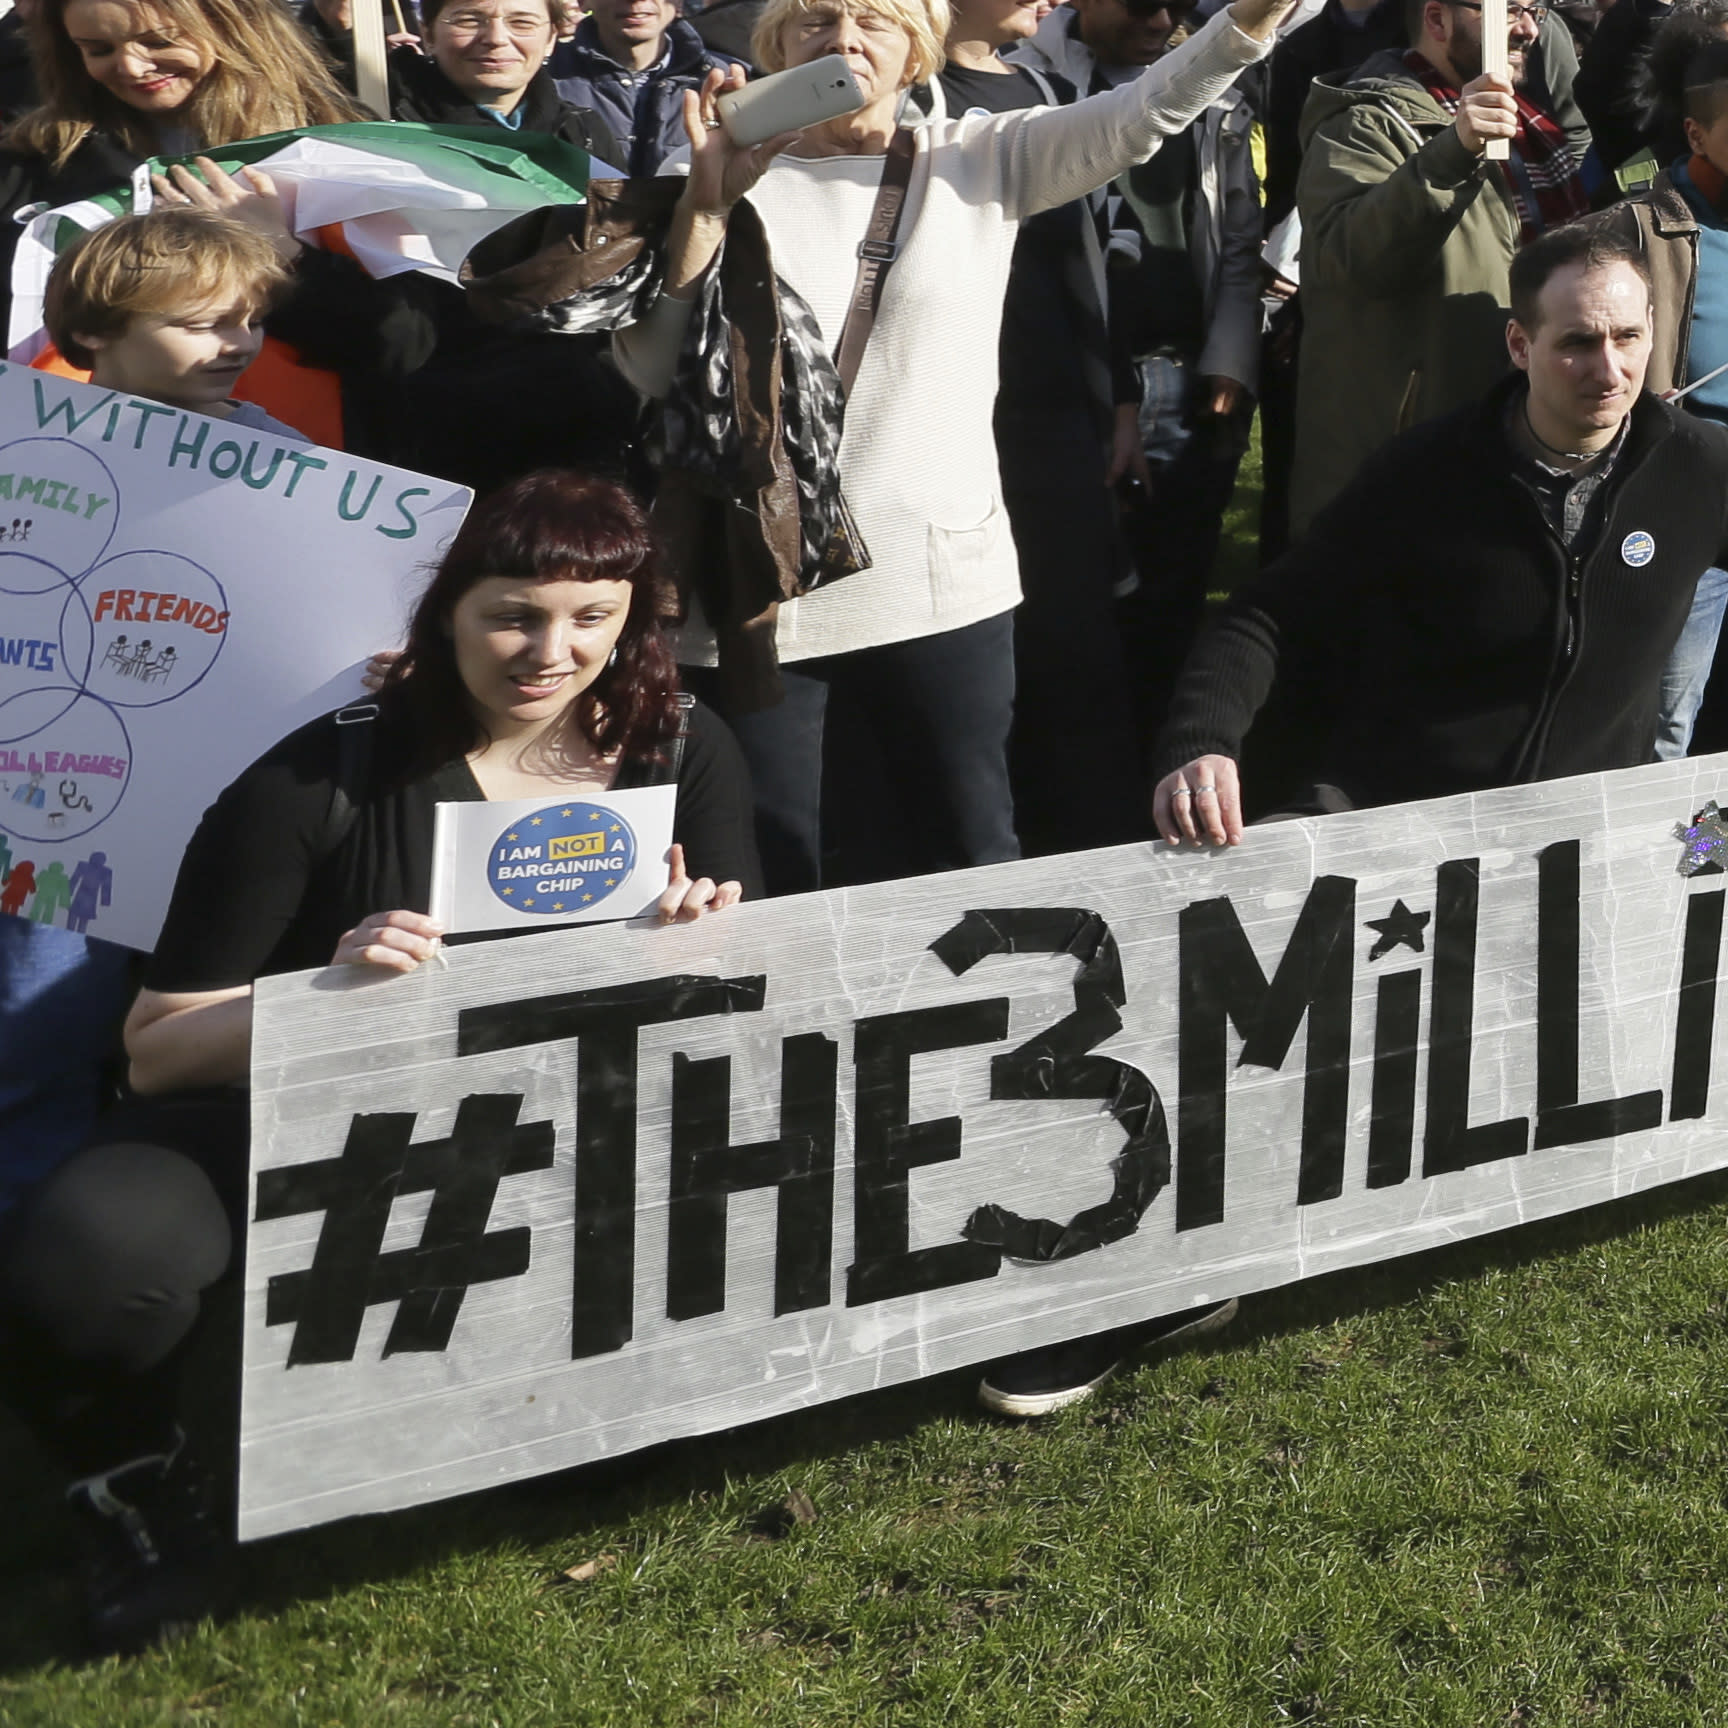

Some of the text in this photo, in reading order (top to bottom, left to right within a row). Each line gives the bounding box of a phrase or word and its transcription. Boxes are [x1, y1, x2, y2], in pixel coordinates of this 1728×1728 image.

[33, 378, 430, 539] WITHOUT US
[94, 589, 231, 634] FRIENDS
[499, 837, 625, 861] I AM NOT A
[497, 857, 624, 880] BARGAINING
[536, 877, 584, 894] CHIP
